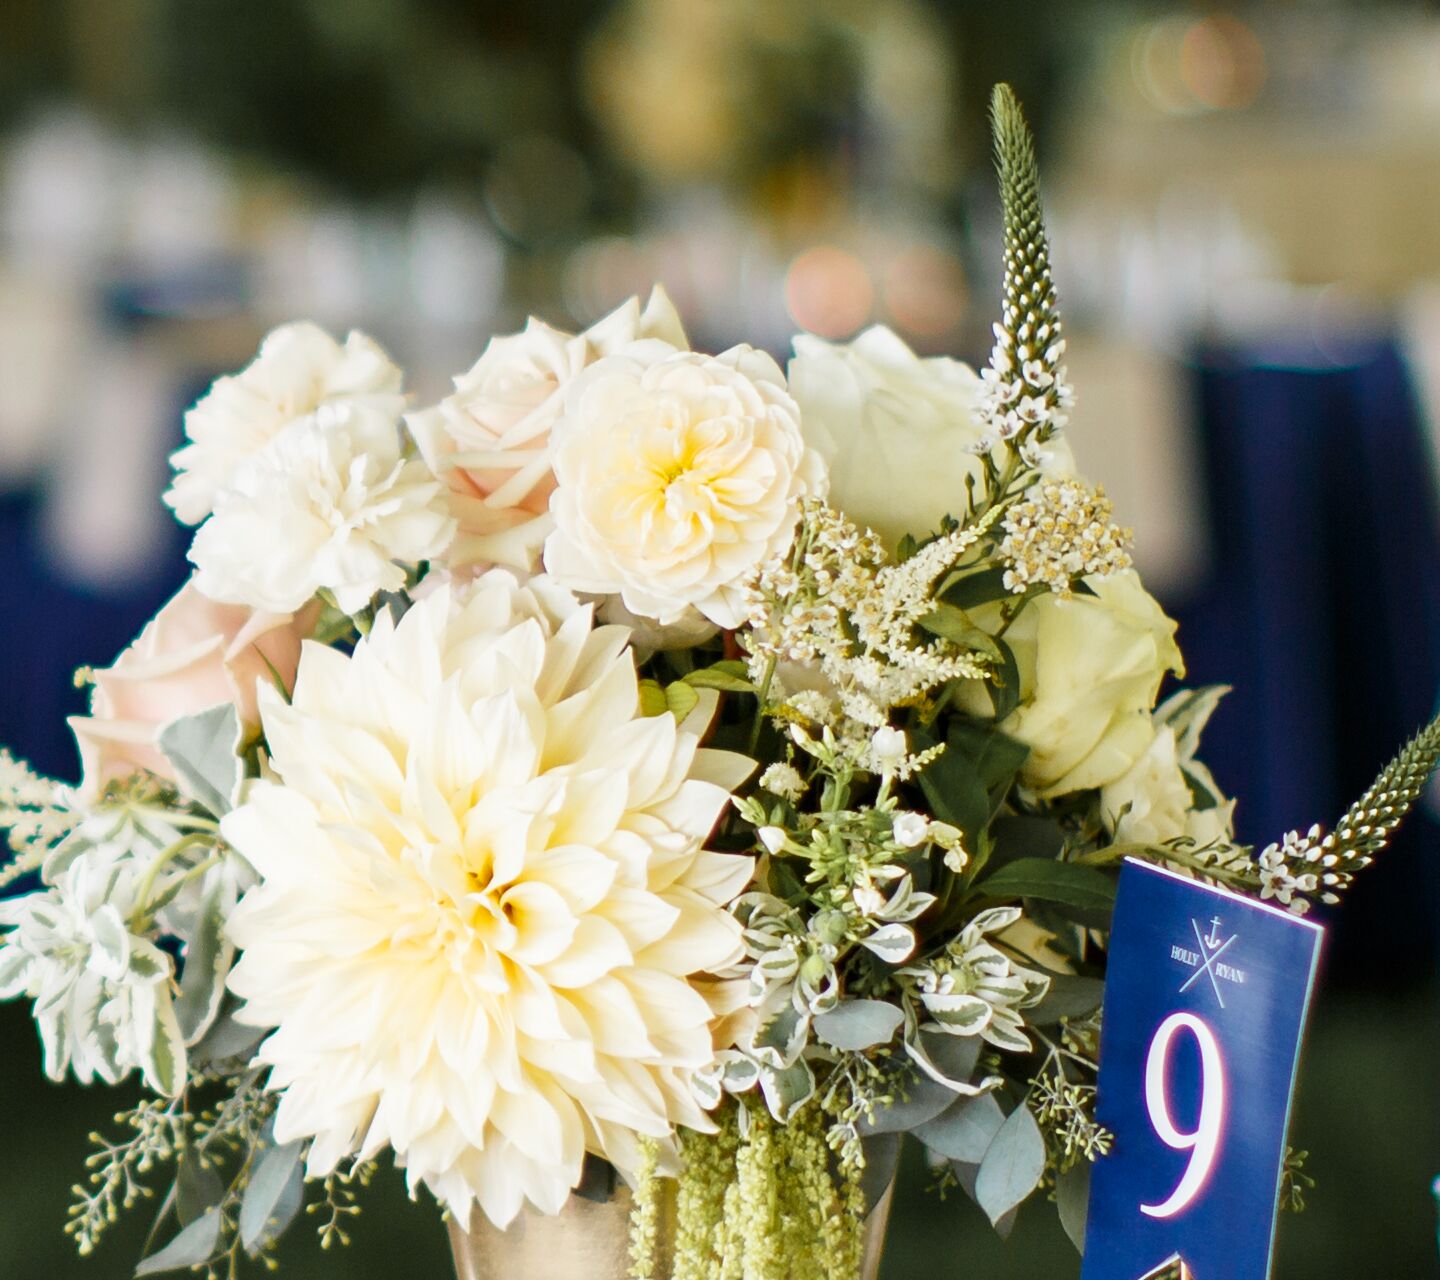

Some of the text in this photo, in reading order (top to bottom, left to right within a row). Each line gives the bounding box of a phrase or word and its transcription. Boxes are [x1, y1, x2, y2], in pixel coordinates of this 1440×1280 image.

[1170, 945, 1245, 984] HOLLY RYAN
[1140, 1012, 1224, 1218] 9
